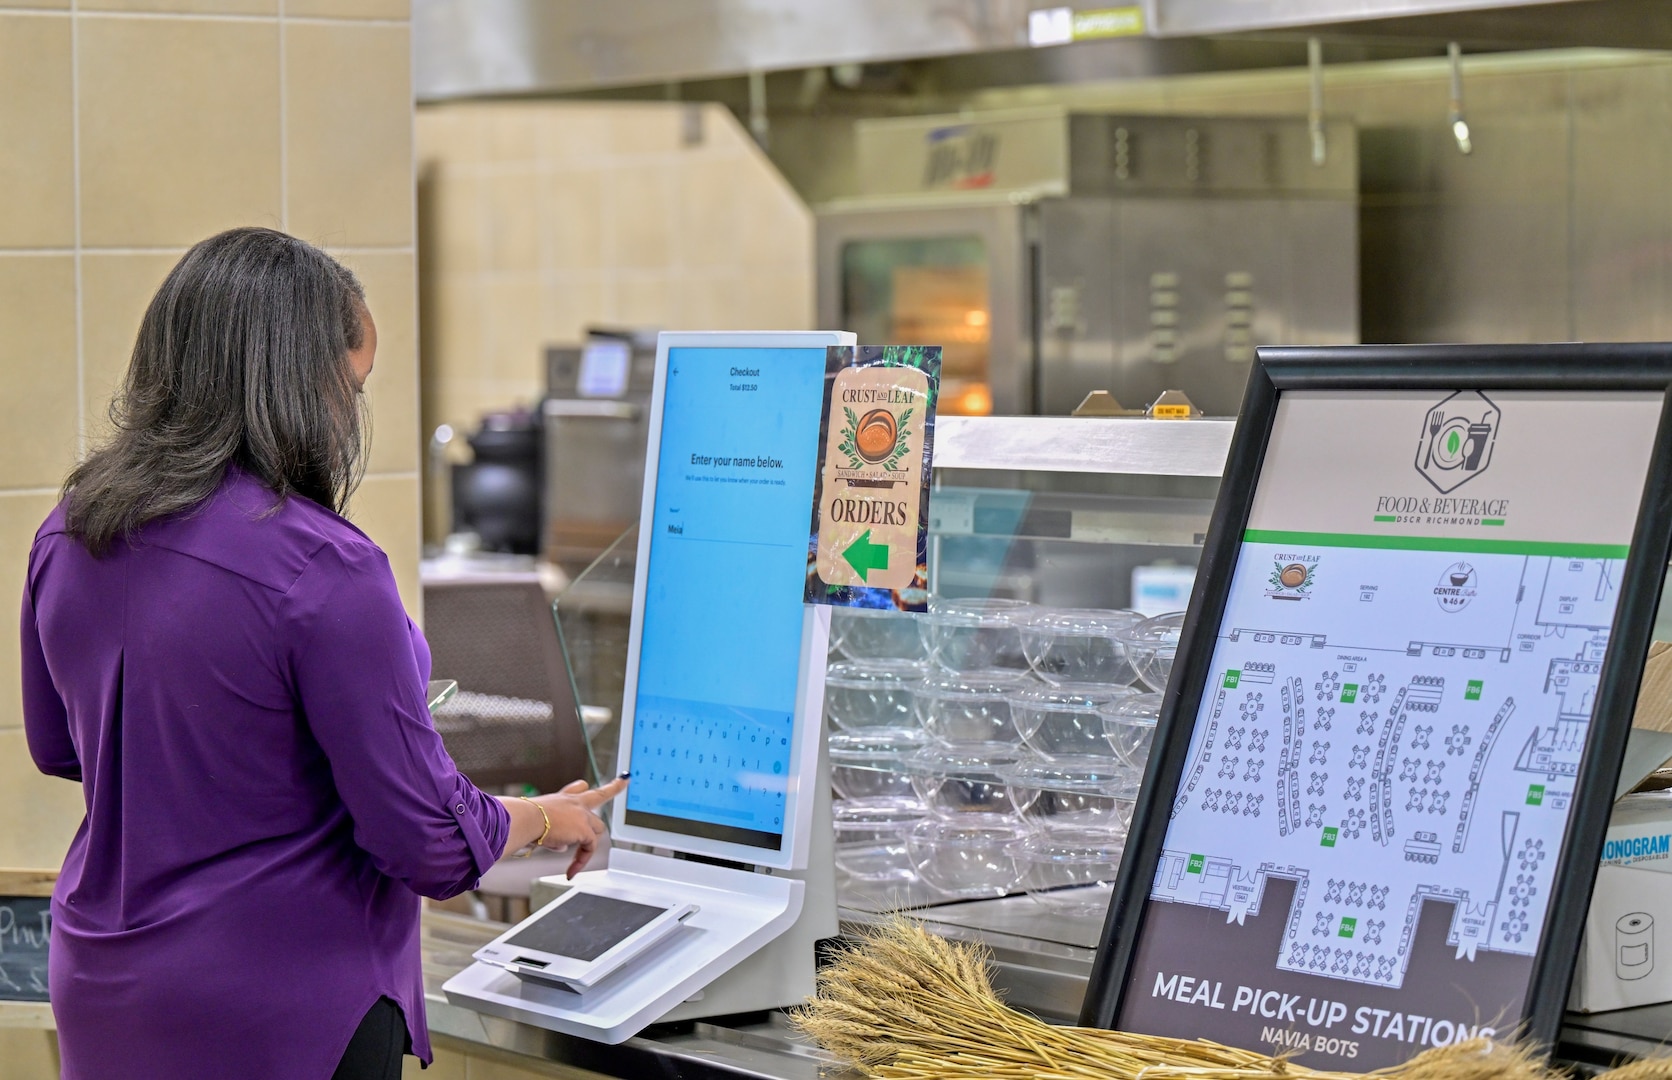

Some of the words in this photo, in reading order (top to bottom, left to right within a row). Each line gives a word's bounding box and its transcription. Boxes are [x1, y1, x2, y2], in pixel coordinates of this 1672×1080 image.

[730, 367, 760, 376] Checkout
[842, 389, 877, 402] CRUST
[888, 390, 915, 403] LEAF
[690, 453, 712, 465] Enter
[713, 456, 731, 468] your
[733, 458, 756, 468] name
[757, 456, 784, 468] below.
[837, 470, 865, 479] SANDWICH
[831, 498, 907, 526] ORDERS
[1376, 496, 1418, 513] FOOD
[1419, 498, 1431, 513] &
[1433, 498, 1509, 516] BEVERAGE
[1426, 517, 1480, 526] RICHMOND
[1434, 587, 1461, 596] CENTRE
[1601, 834, 1670, 860] ONOGRAM
[1633, 854, 1669, 863] DISPOSABLES
[1341, 924, 1354, 932] FB4
[1152, 972, 1225, 1009] MEAL
[1232, 986, 1348, 1028] PICK-UP
[1260, 1026, 1310, 1050] NAVIA
[1314, 1036, 1359, 1058] BOTS
